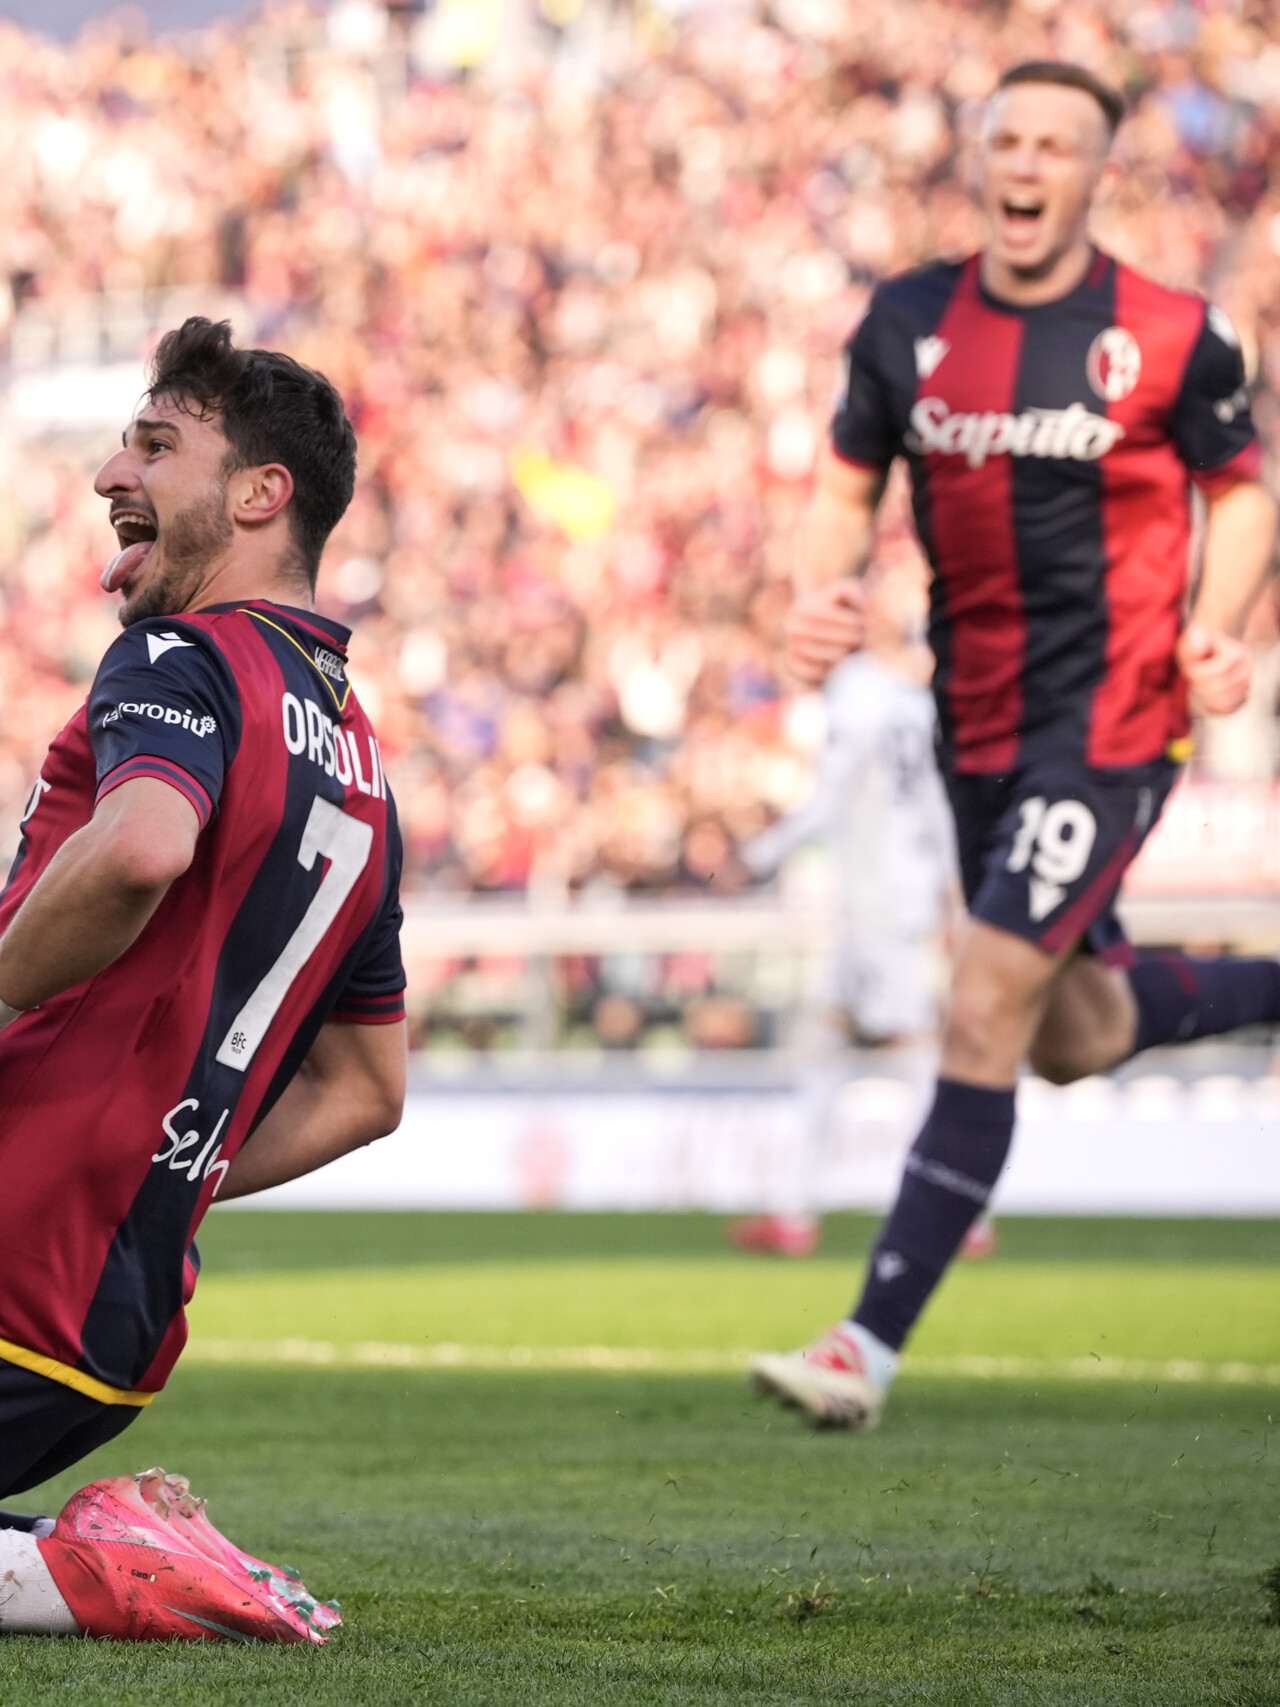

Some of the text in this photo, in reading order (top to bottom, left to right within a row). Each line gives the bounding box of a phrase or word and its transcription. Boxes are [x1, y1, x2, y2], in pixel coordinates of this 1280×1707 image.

[904, 397, 1125, 470] Saputo
[1006, 796, 1097, 885] 19
[216, 795, 375, 1072] 7
